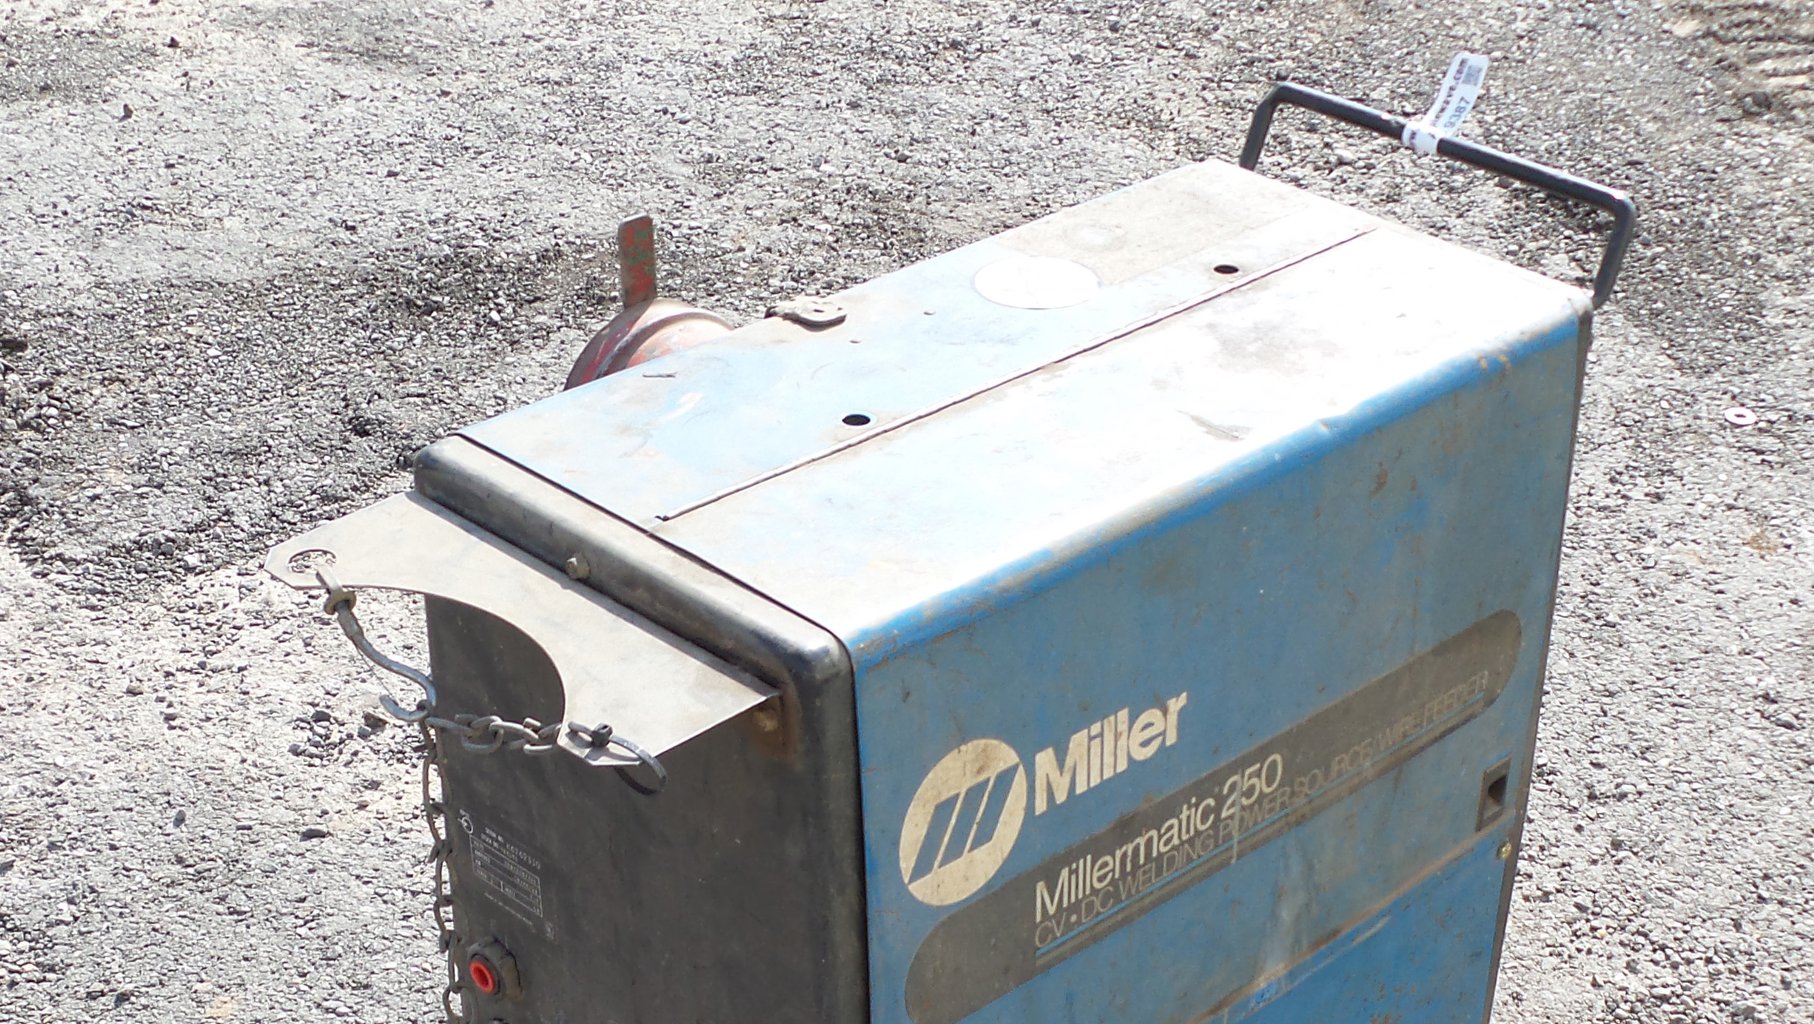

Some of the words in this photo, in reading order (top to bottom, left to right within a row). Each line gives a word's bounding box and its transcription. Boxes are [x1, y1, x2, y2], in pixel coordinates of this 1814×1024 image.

[1035, 691, 1188, 816] Miller
[1036, 796, 1216, 923] Millermatic
[1221, 753, 1283, 819] 250
[1119, 830, 1214, 900] WELDING
[1219, 786, 1291, 845] POWER
